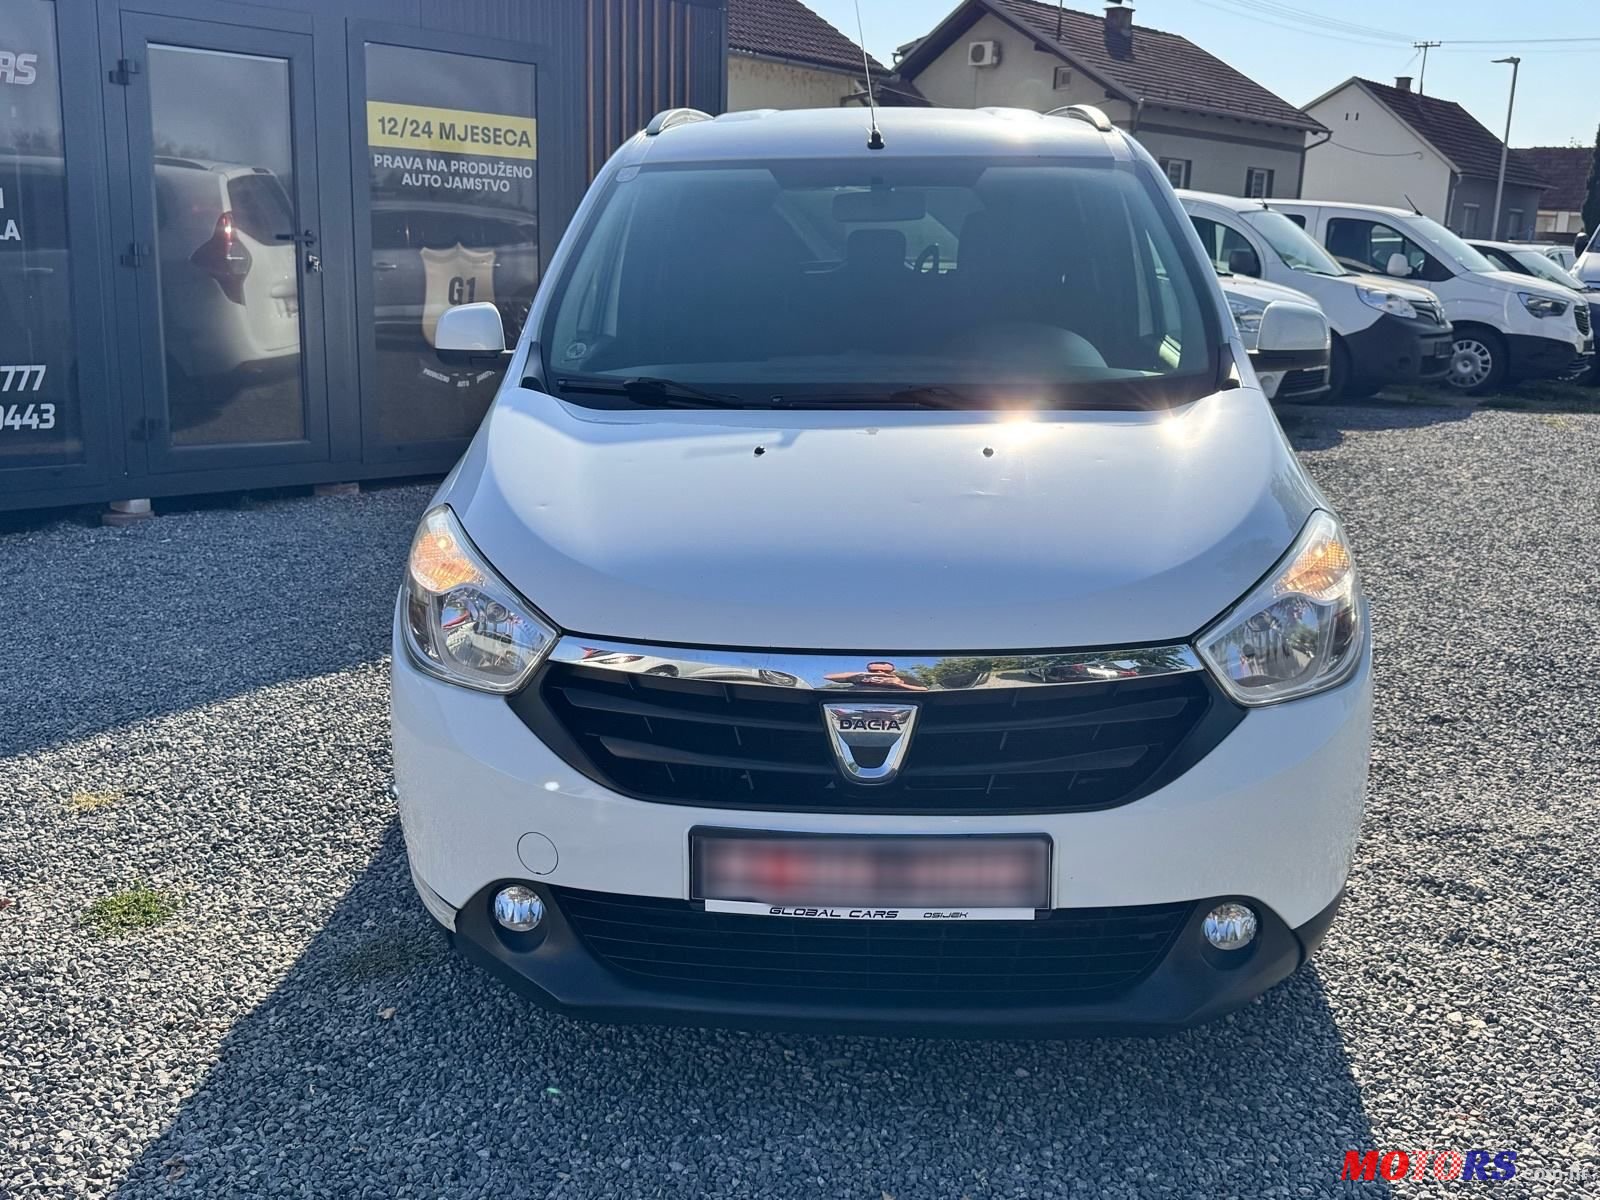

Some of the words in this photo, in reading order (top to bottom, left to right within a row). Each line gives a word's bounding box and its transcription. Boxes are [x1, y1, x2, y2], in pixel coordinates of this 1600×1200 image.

[378, 116, 433, 138] 12/24
[439, 122, 532, 148] MJESECA
[374, 154, 423, 170] PRAVA
[426, 158, 447, 172] NA
[451, 160, 533, 179] PRODUŽENO
[402, 173, 441, 187] AUTO
[444, 176, 510, 192] JAMSTVO
[0, 219, 21, 241] A
[448, 276, 476, 306] G1
[0, 365, 46, 392] 777
[840, 719, 901, 731] DACIA
[769, 907, 841, 918] GLOBAL
[849, 910, 899, 919] CARS
